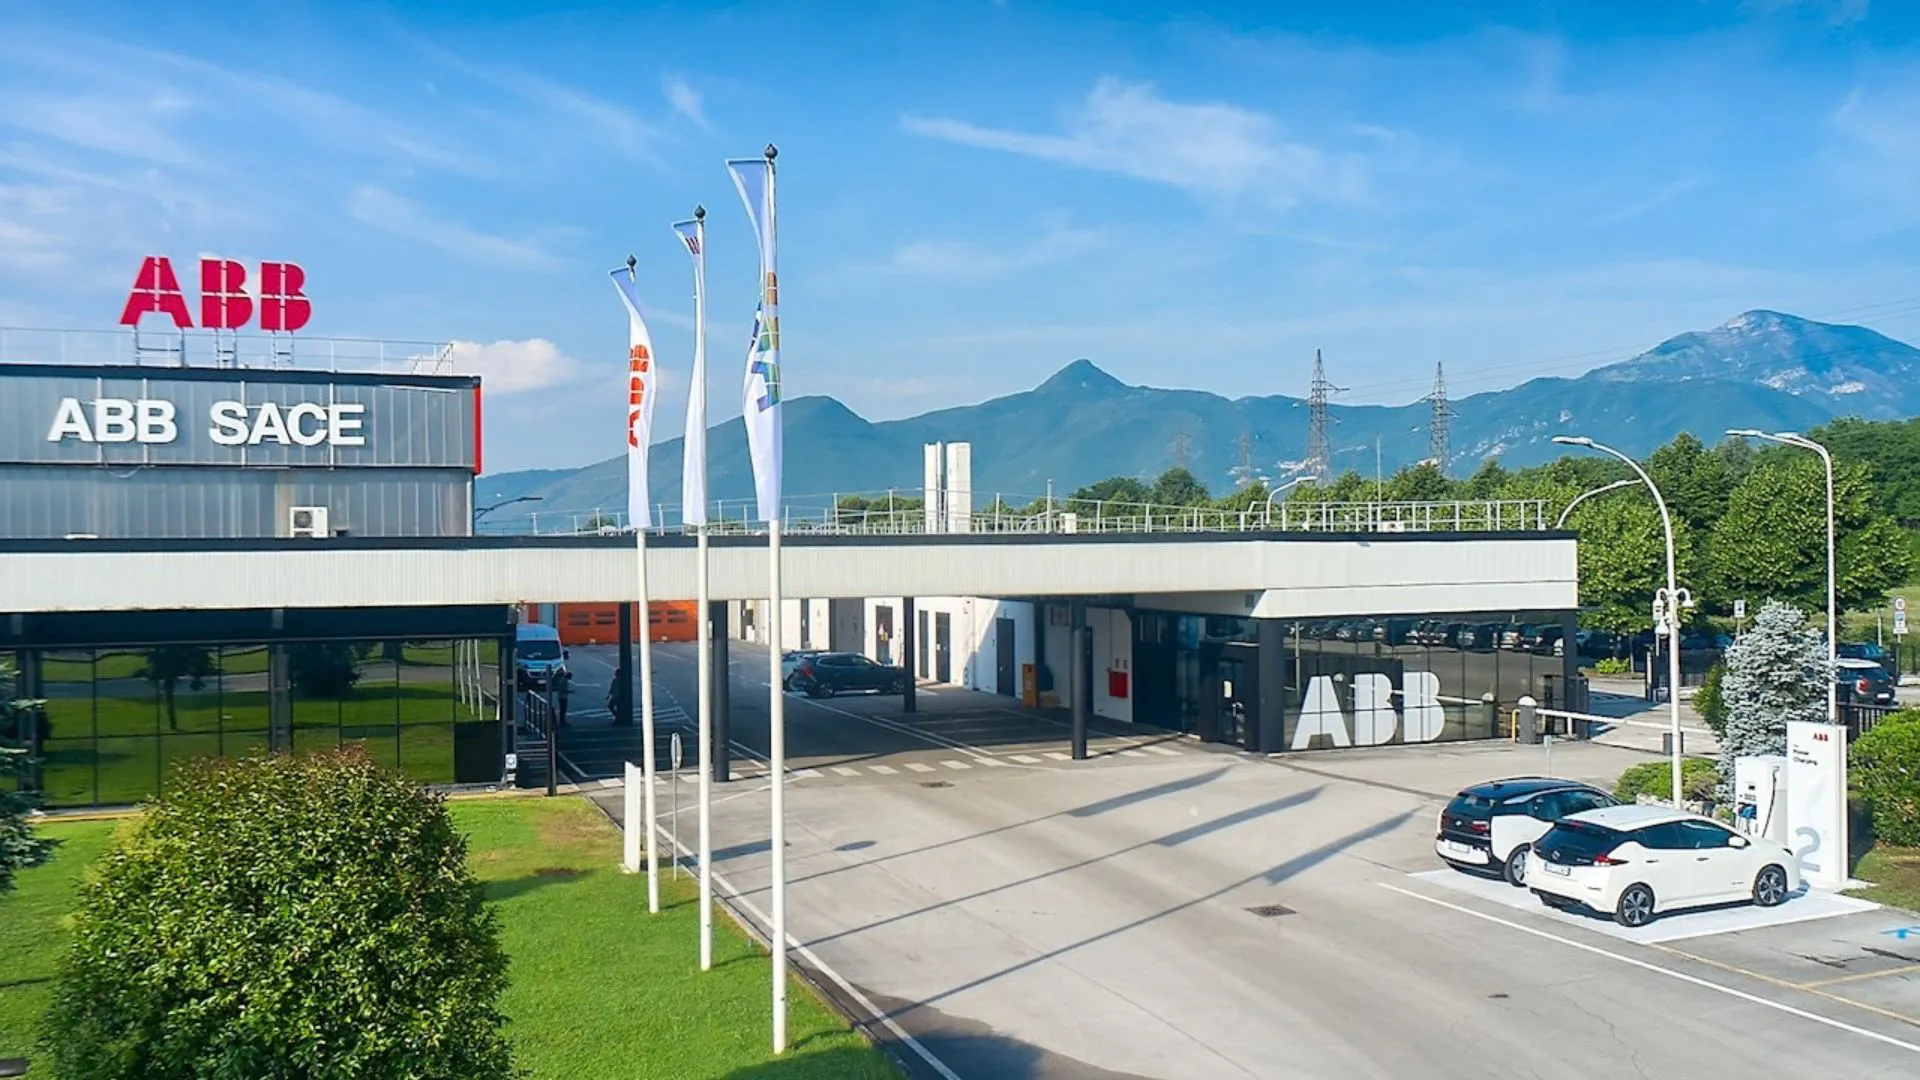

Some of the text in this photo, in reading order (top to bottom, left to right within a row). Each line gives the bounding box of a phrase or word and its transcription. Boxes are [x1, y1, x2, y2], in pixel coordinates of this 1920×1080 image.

[119, 256, 313, 331] ABB
[47, 397, 366, 446] ABB SACE
[1291, 672, 1445, 749] ABB
[1812, 732, 1828, 741] ABB
[1795, 826, 1821, 873] 2
